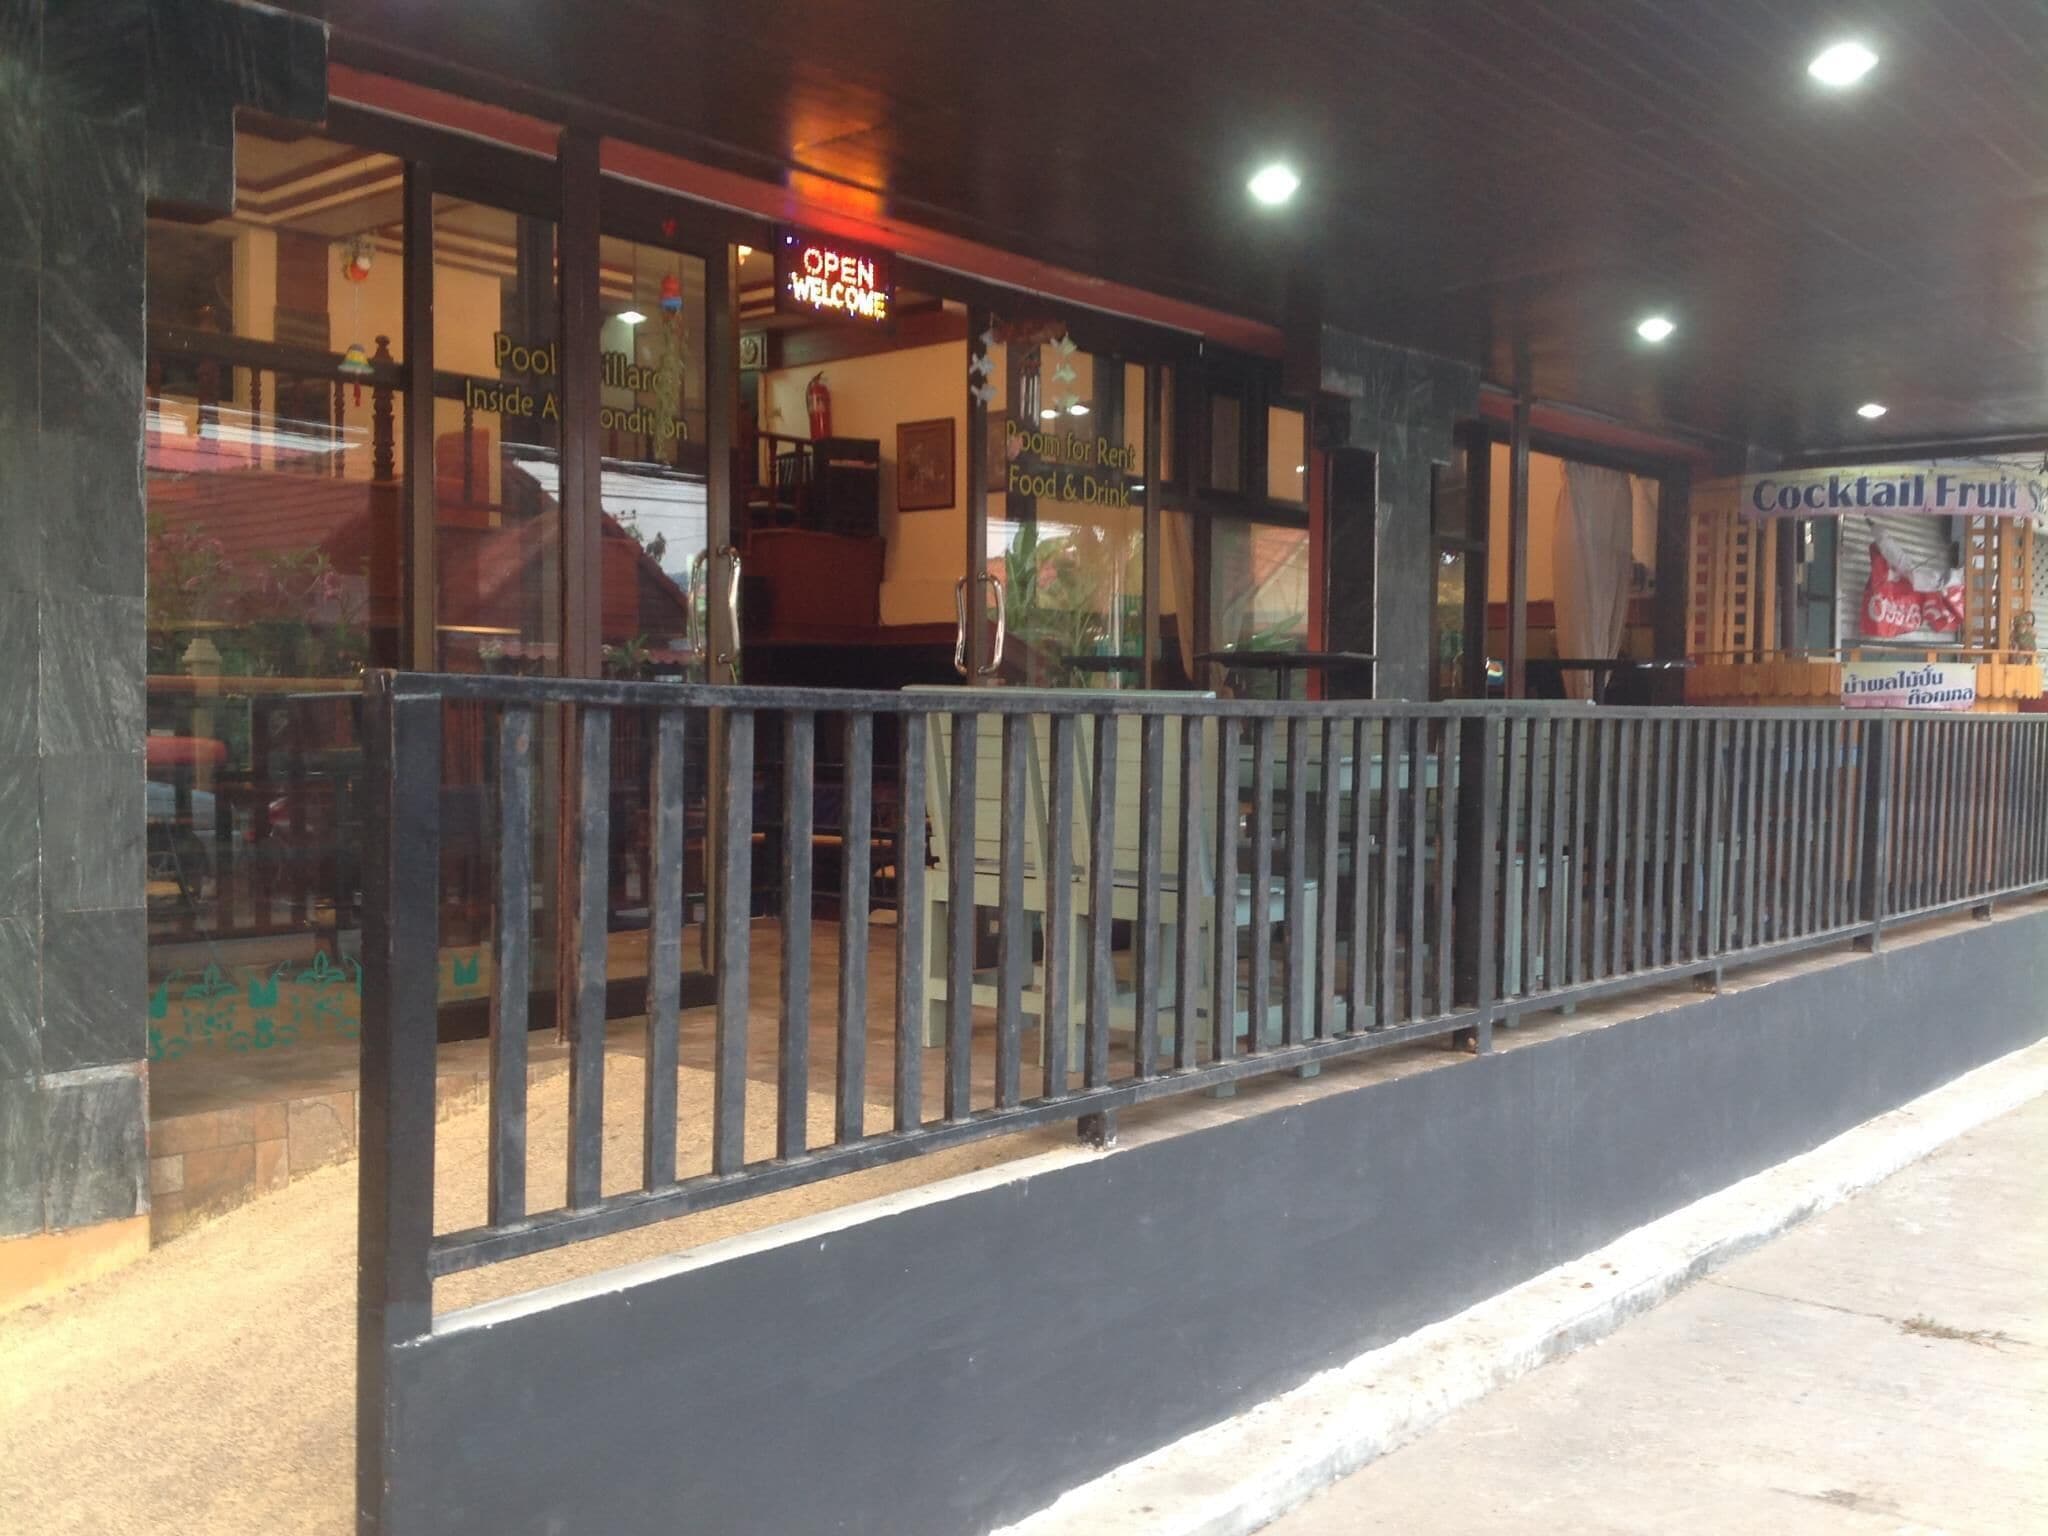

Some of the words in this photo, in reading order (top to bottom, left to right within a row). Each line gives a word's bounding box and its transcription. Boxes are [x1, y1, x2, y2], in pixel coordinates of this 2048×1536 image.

[803, 247, 874, 289] OPEN
[791, 272, 886, 318] WELCOME
[494, 331, 557, 376] Pool
[601, 349, 676, 394] illar
[466, 378, 534, 417] Inside
[600, 401, 688, 441] onditon
[1007, 419, 1060, 458] Room
[1066, 431, 1092, 462] for
[1097, 436, 1136, 470] Rent
[1009, 464, 1057, 499] Food
[1063, 473, 1078, 501] &
[1083, 475, 1131, 508] Drink
[1753, 474, 1925, 512] Cocktail
[1936, 475, 2017, 509] Fruit
